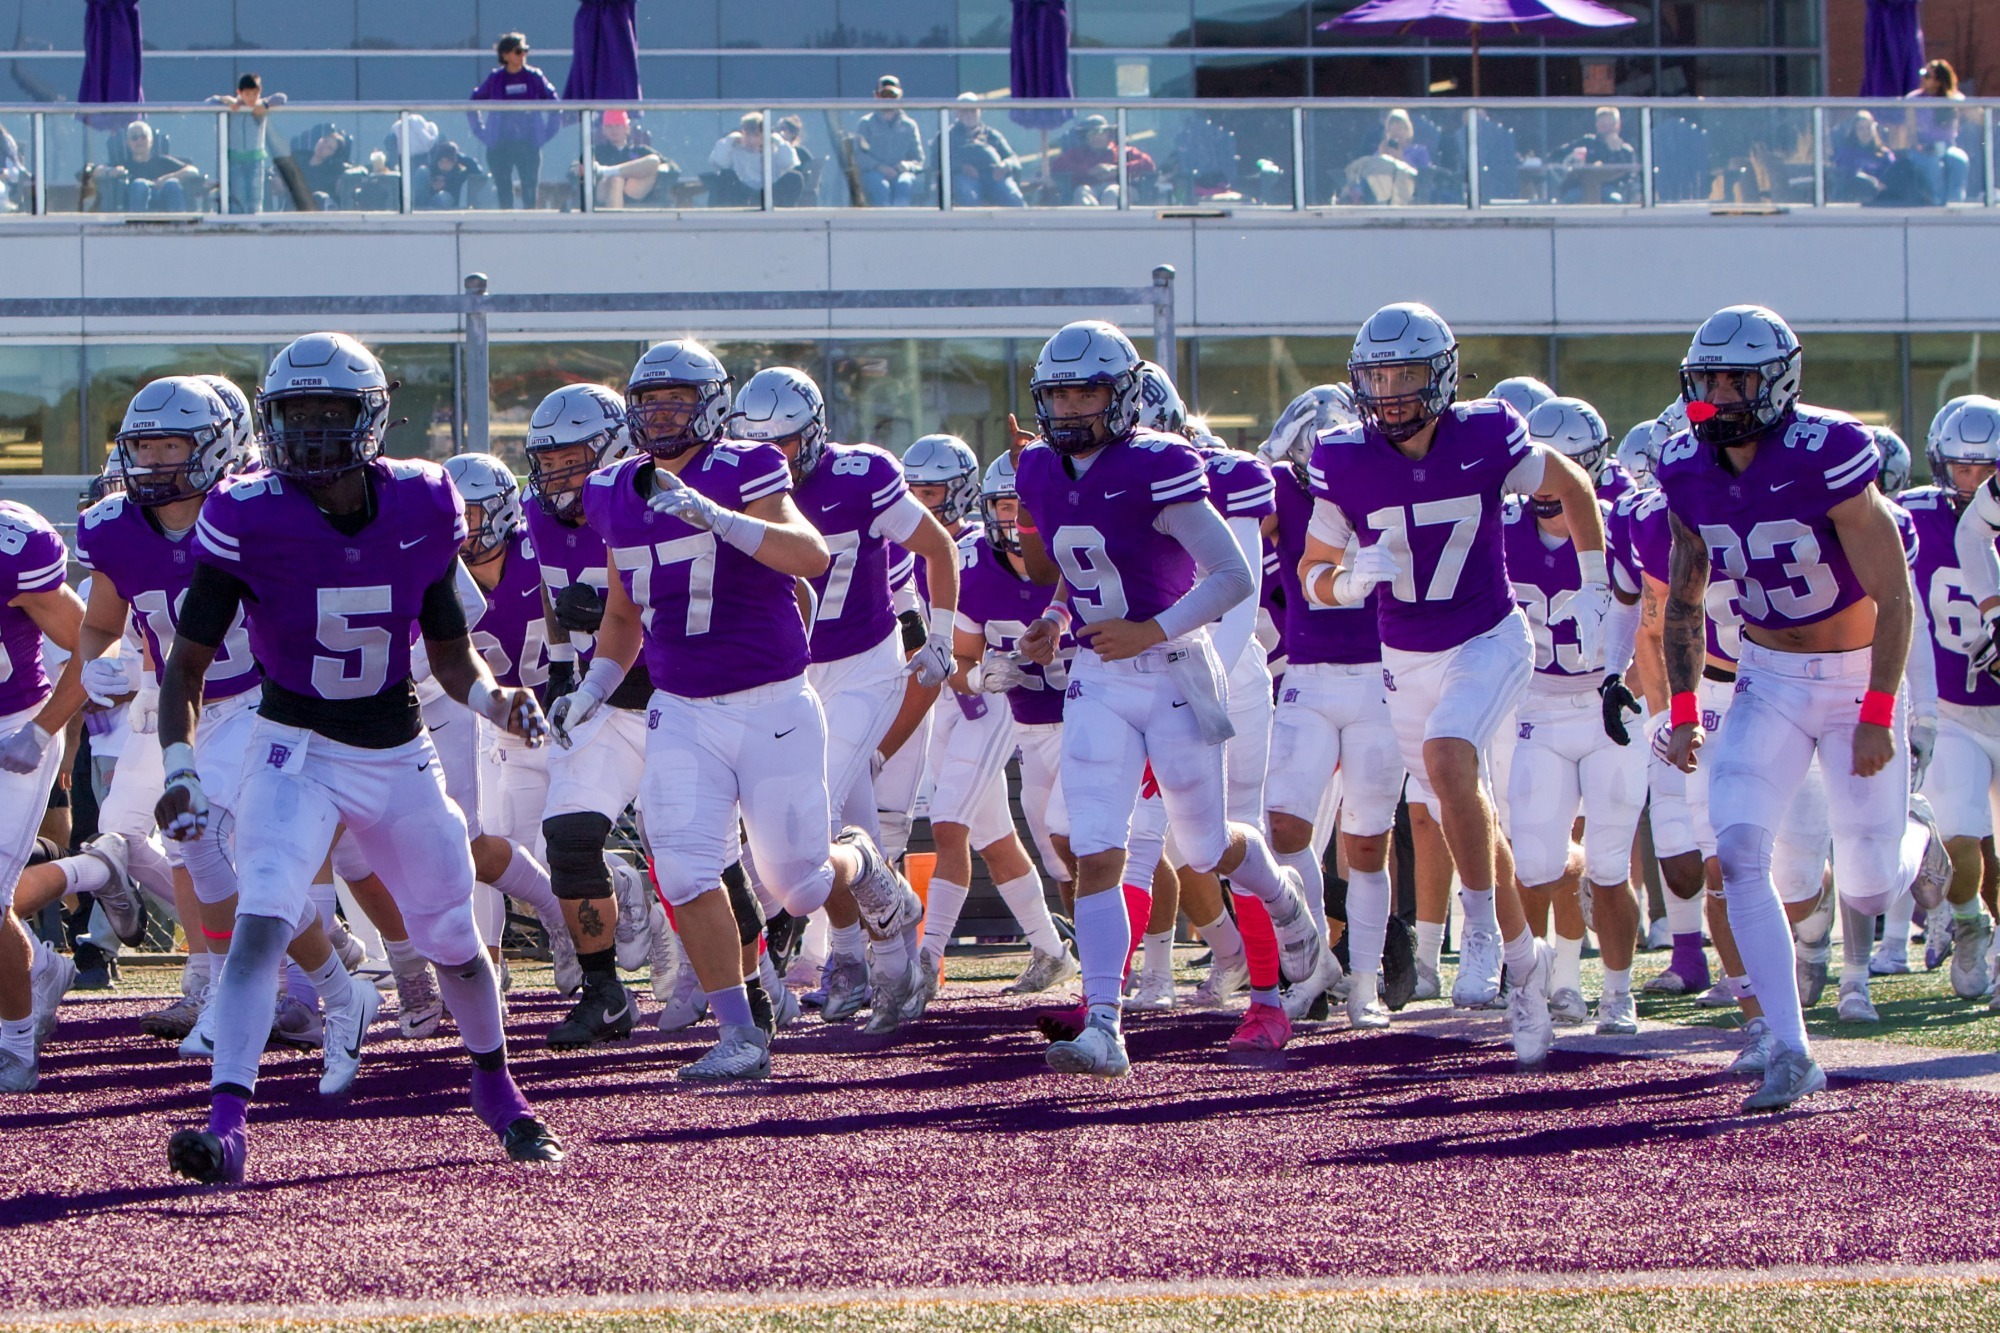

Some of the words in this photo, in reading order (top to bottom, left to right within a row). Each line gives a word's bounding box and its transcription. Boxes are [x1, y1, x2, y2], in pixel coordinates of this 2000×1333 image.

[132, 421, 156, 429] GAITERS
[611, 531, 717, 637] 77
[1053, 526, 1129, 626] 9
[1367, 493, 1482, 603] 17
[1698, 518, 1840, 620] 33
[311, 584, 392, 700] 5
[1702, 709, 1722, 732] BU
